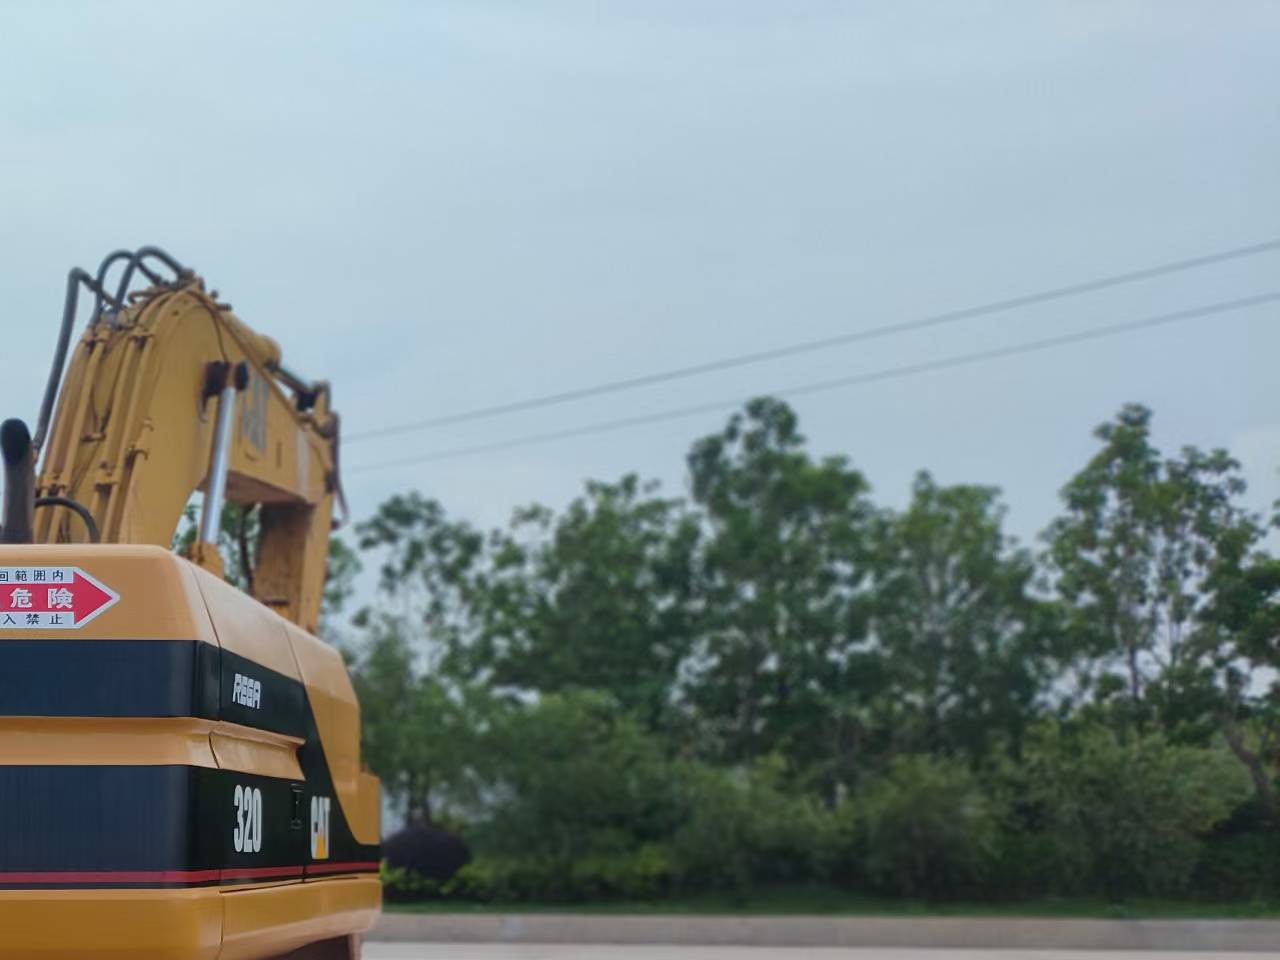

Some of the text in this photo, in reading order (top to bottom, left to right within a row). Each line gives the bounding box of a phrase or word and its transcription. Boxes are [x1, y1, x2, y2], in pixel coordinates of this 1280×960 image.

[10, 587, 74, 608] 危険
[233, 784, 263, 853] 320
[310, 795, 331, 860] CAT
